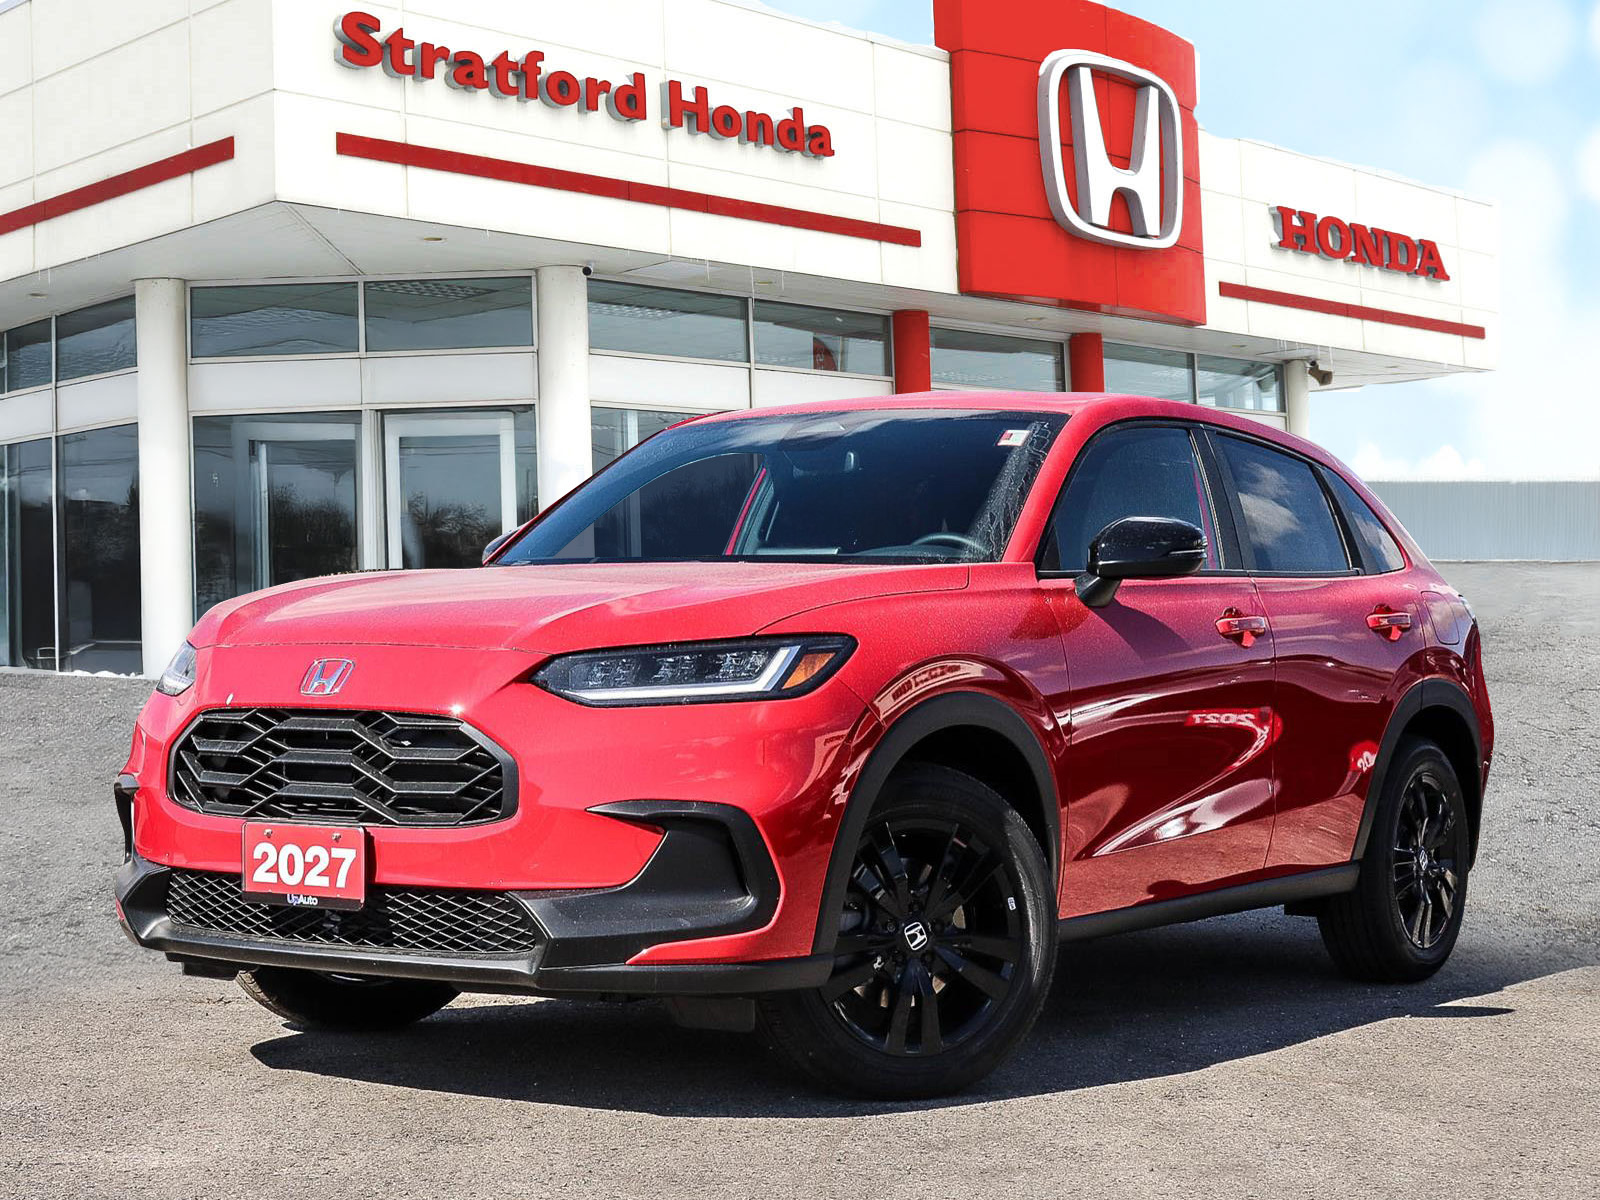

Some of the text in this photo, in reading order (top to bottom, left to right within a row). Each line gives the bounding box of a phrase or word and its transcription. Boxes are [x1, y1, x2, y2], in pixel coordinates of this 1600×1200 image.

[334, 11, 835, 158] Stratford Honda
[1271, 205, 1450, 281] HONDA
[252, 841, 357, 889] 2027
